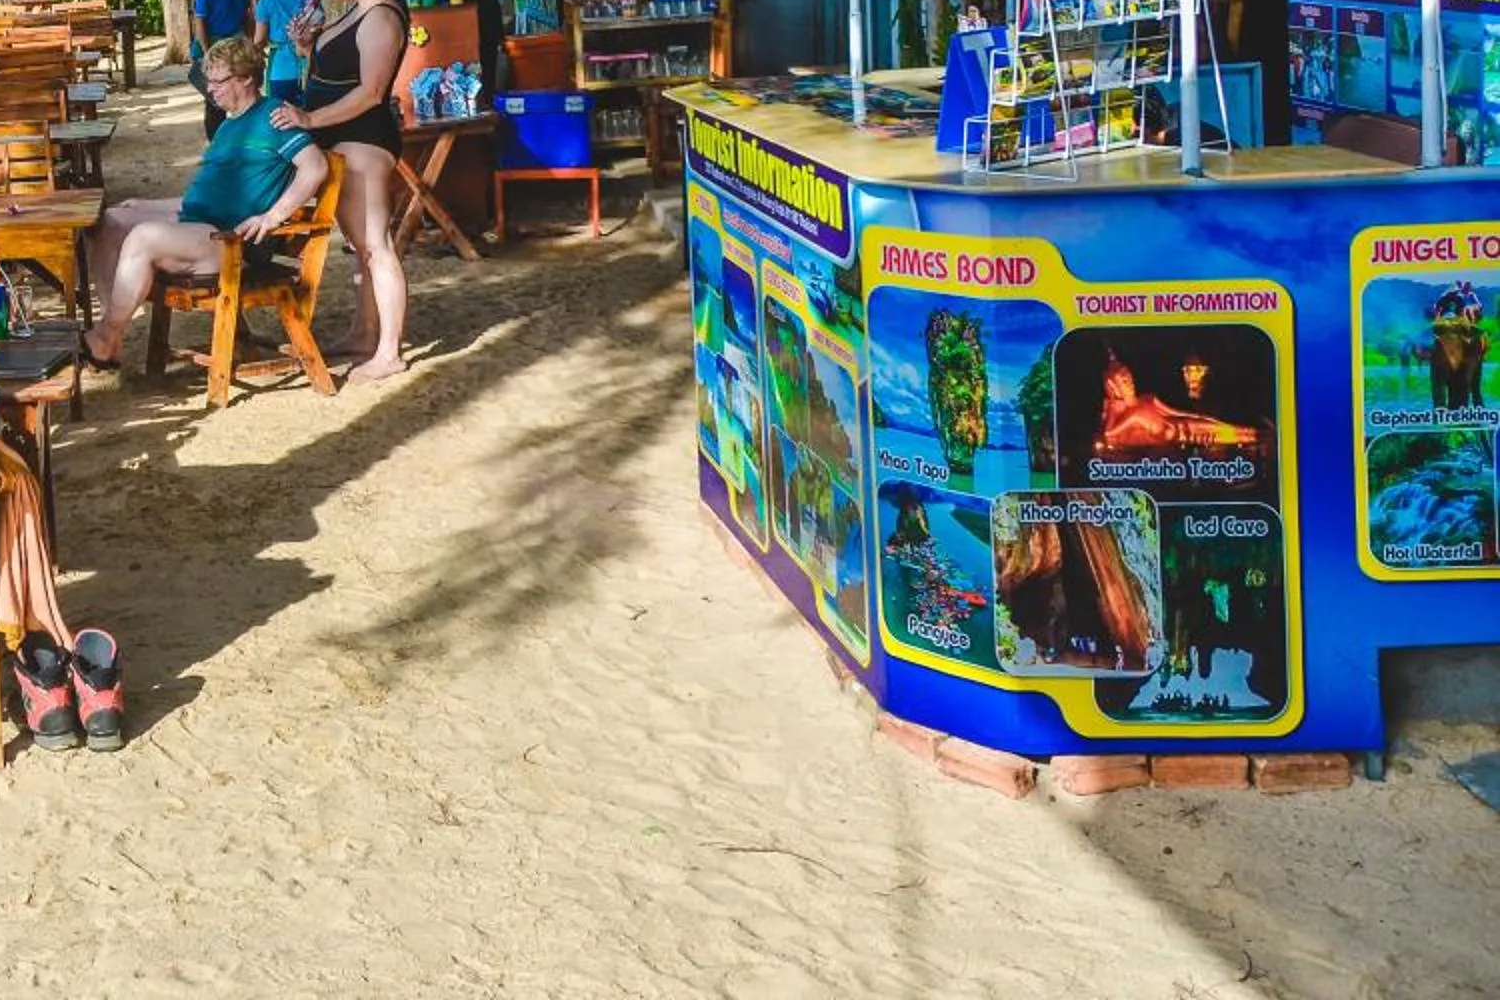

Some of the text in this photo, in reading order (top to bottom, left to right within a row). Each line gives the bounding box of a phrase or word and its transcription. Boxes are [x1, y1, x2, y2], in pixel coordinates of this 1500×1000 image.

[686, 105, 736, 174] Tourist
[736, 129, 844, 232] Information
[1371, 237, 1458, 264] JUNGEL
[880, 244, 1037, 286] JAMES BOND
[1076, 292, 1278, 315] TOURIST INFORMATION
[1438, 406, 1500, 426] Trekking
[914, 456, 949, 481] Tapu
[1089, 457, 1254, 481] Suwankuha Temple
[1020, 502, 1134, 526] Khao Pingkan
[1222, 517, 1268, 537] Cave
[1384, 542, 1482, 562] Hot Waterfall
[907, 614, 971, 650] Pangyee
